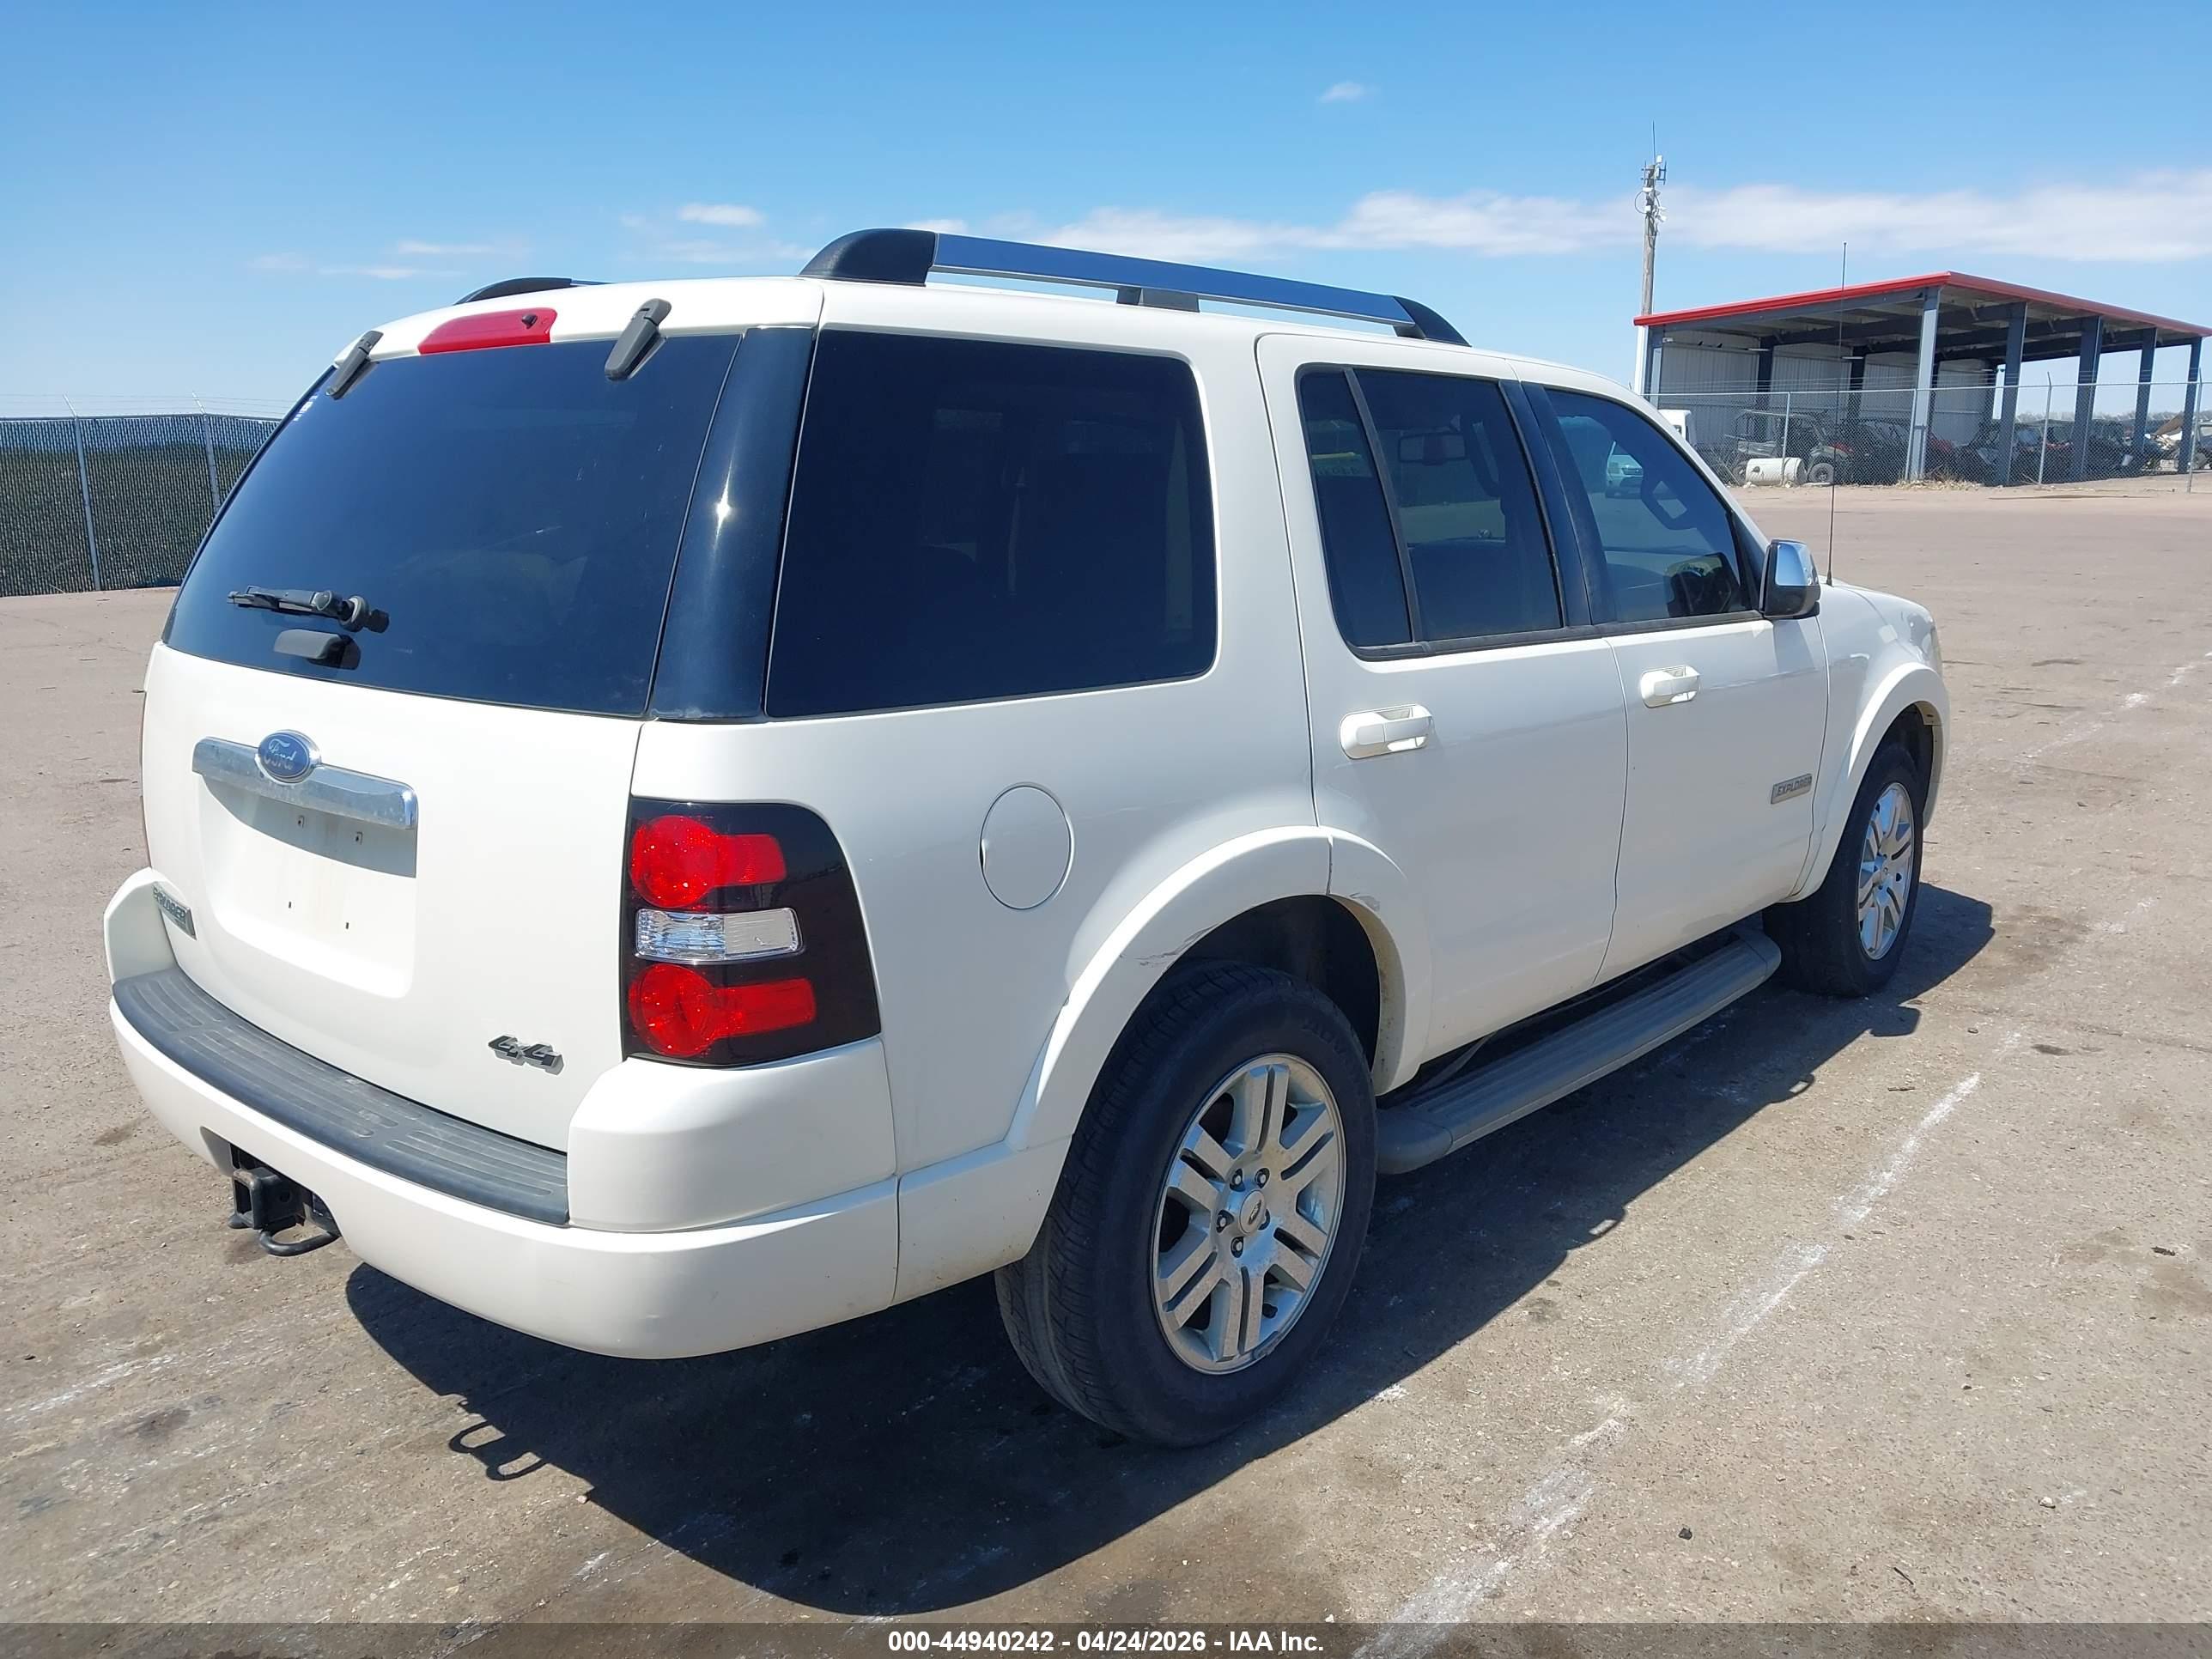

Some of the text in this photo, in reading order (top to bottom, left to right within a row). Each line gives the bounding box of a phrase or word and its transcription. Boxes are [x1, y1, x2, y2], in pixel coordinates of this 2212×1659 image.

[269, 738, 297, 761] Ford
[1776, 775, 1812, 797] EXPLORER
[153, 884, 187, 924] EXPLORER
